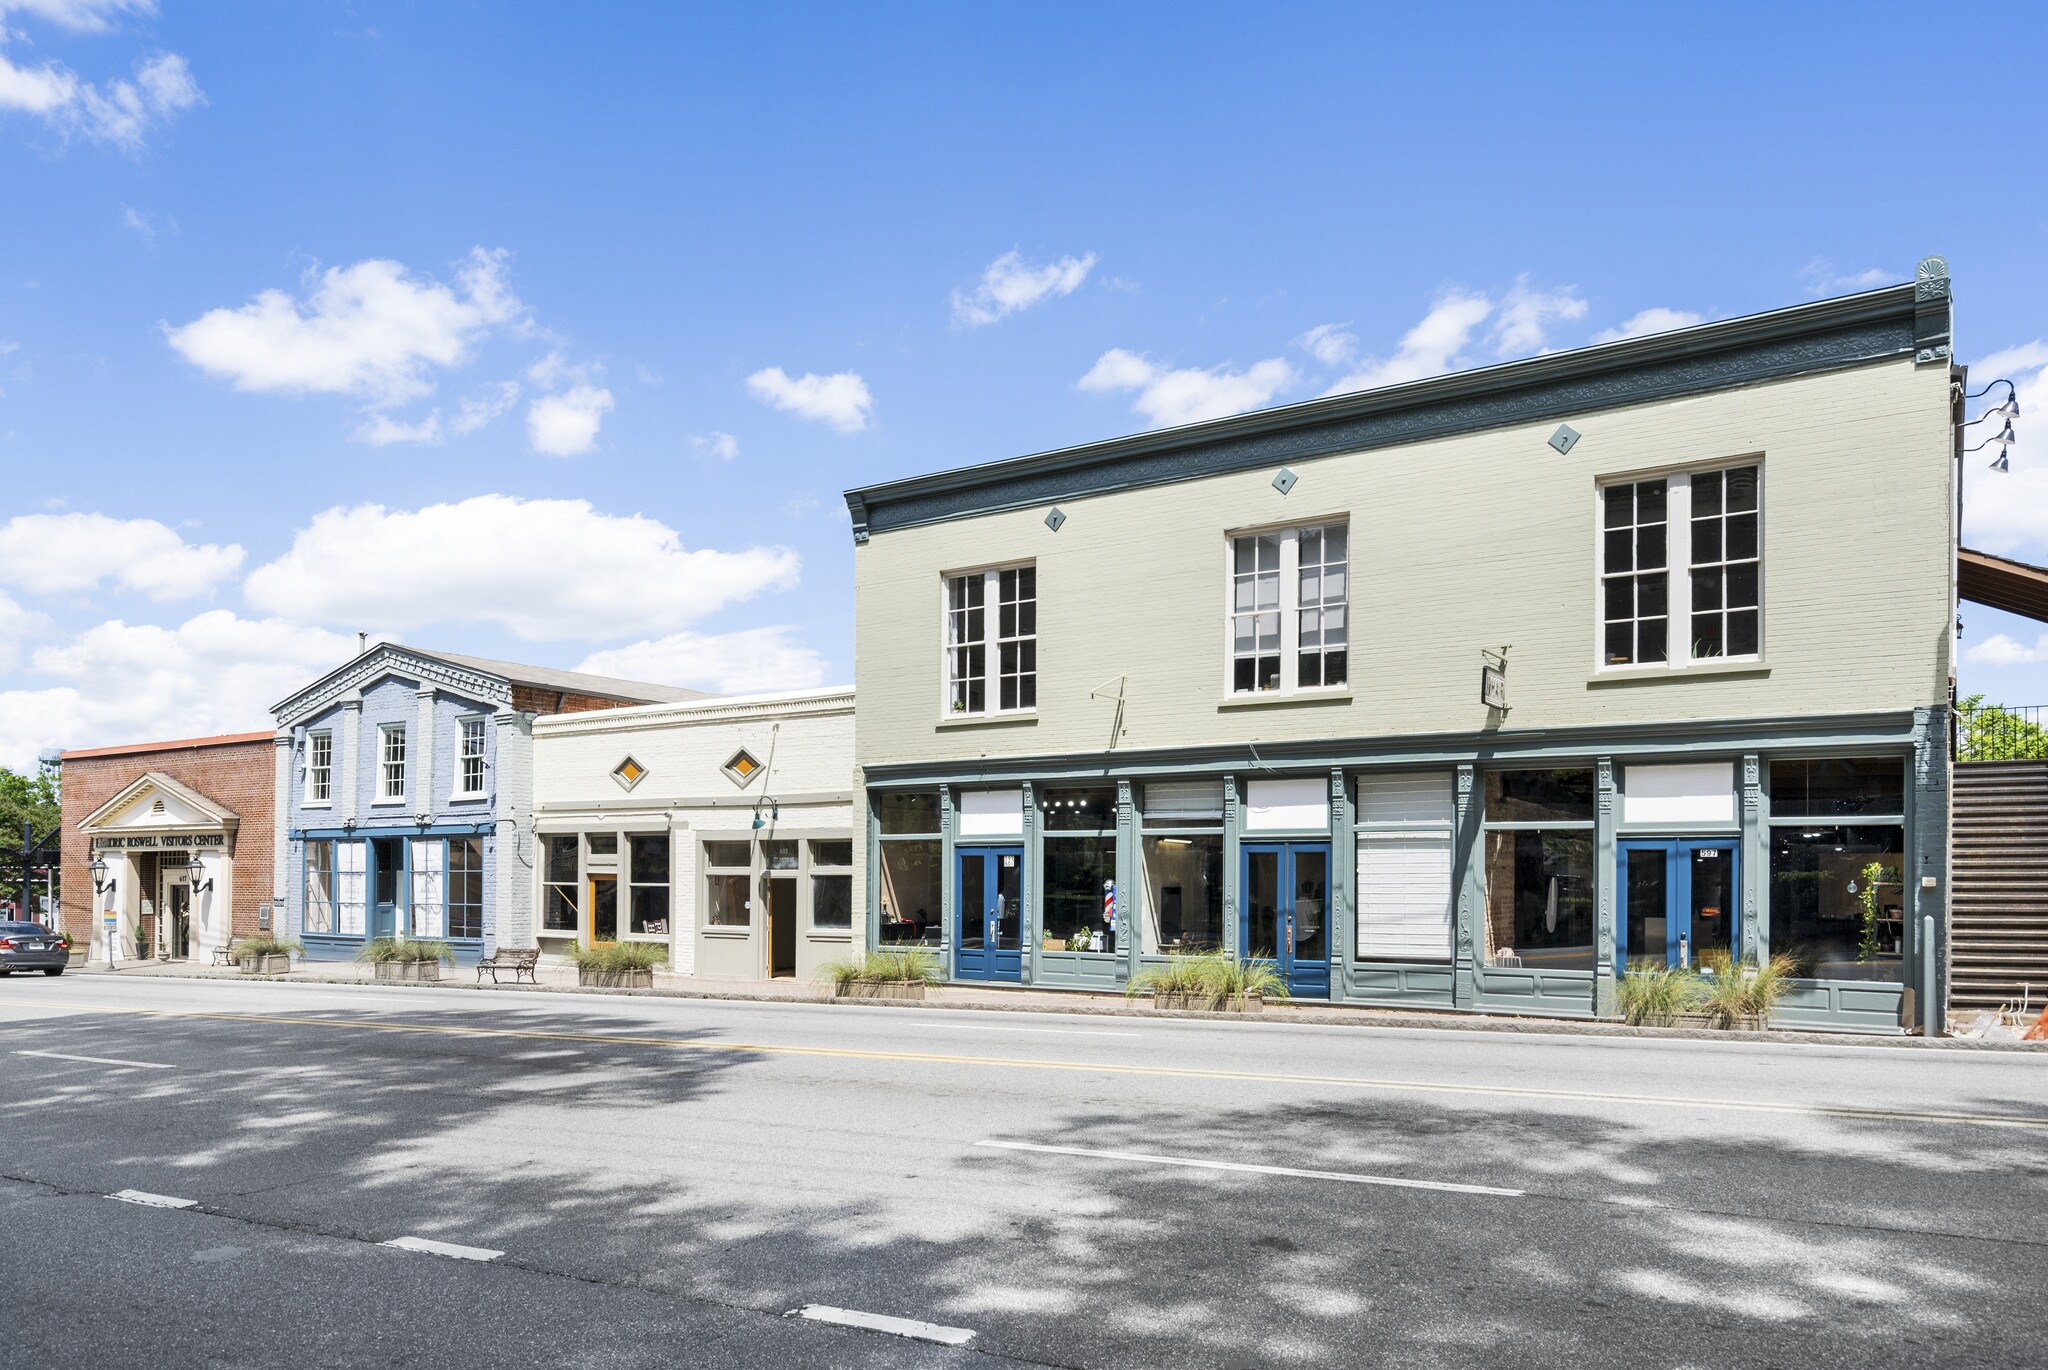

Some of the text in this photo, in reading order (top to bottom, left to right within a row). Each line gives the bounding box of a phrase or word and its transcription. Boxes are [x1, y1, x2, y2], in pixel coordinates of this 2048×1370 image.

[96, 834, 224, 847] HORIC ROSWELL VISITORS CENTER
[1701, 849, 1717, 857] 597
